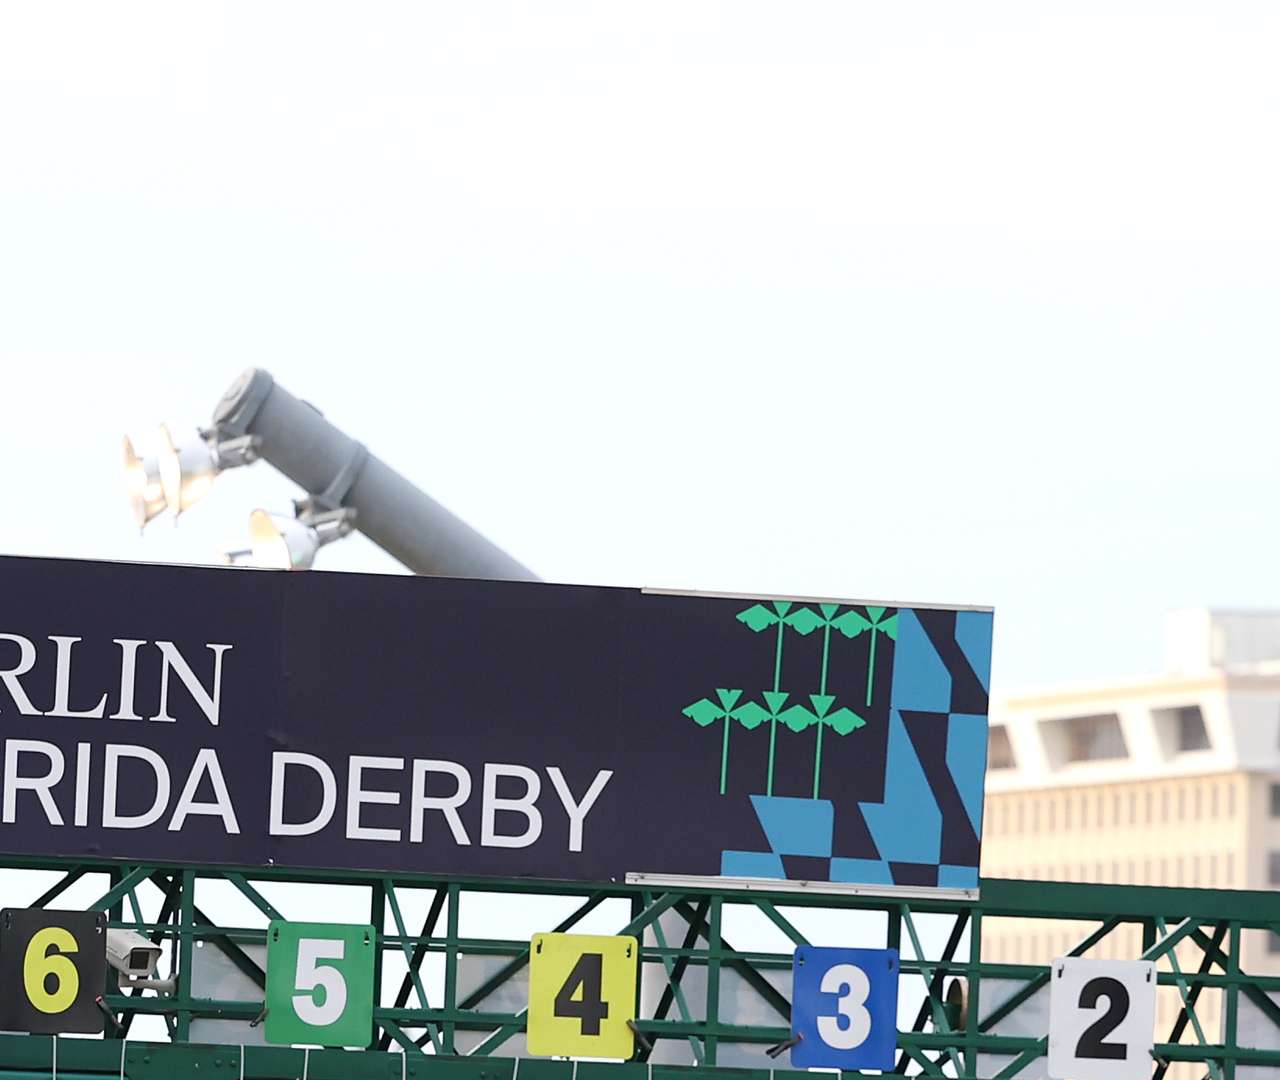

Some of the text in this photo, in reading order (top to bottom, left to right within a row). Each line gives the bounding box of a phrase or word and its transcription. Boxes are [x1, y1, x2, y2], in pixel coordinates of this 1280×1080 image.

[269, 751, 614, 852] DERBY
[23, 926, 79, 1014] 6
[291, 938, 347, 1026] 5
[553, 952, 609, 1036] 4
[816, 964, 872, 1050] 3
[1074, 976, 1130, 1061] 2
